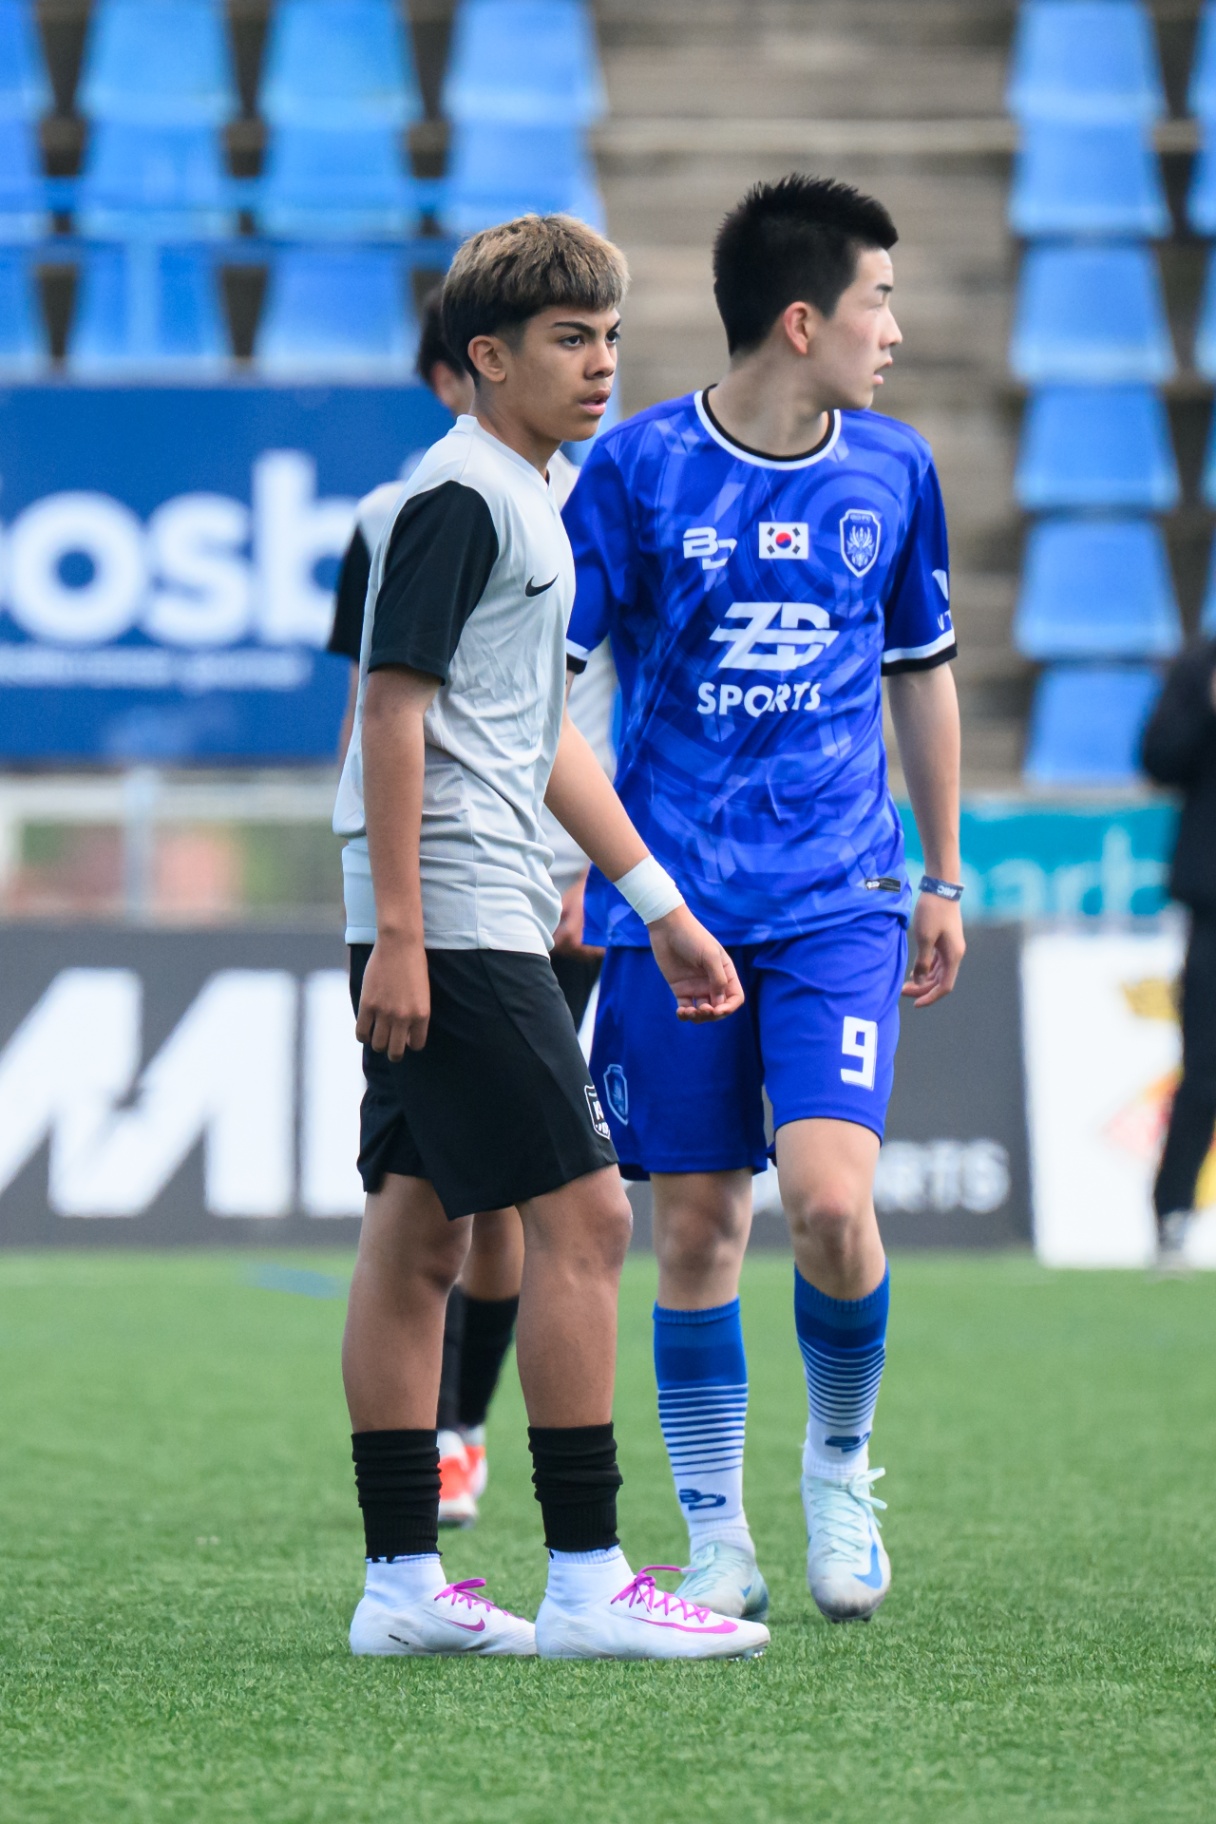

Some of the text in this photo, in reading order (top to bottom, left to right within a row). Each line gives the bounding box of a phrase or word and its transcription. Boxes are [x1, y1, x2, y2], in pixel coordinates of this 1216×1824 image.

[697, 681, 822, 718] SPORTS
[841, 1015, 878, 1091] 9
[0, 967, 372, 1218] MI
